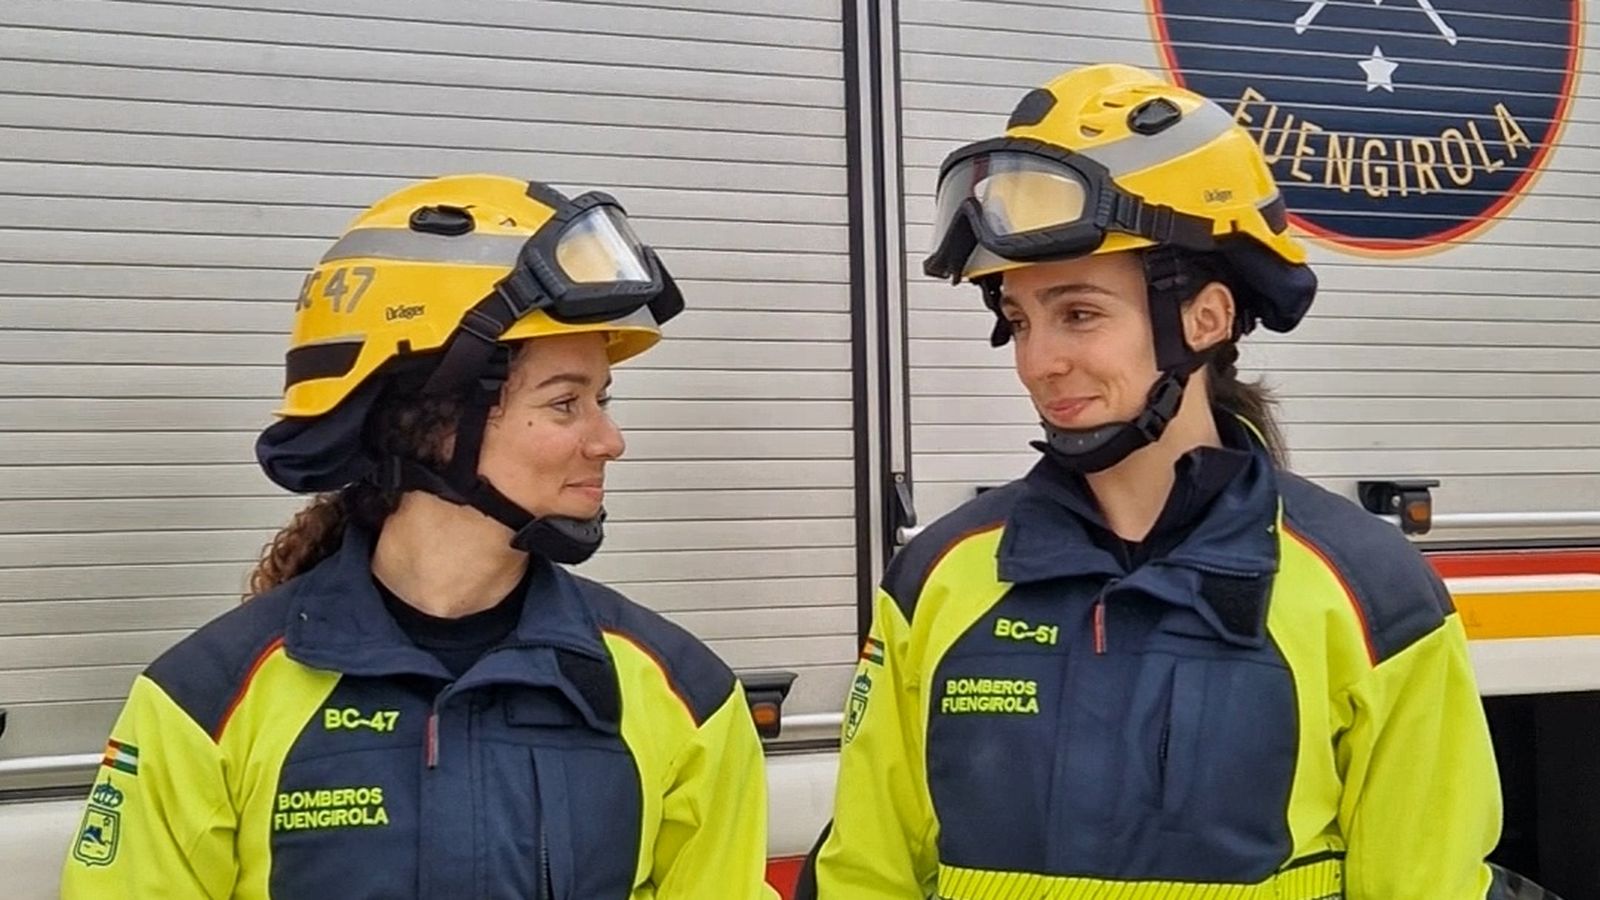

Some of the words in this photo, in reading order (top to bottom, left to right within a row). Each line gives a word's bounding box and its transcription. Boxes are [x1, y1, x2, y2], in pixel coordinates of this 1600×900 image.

[1233, 87, 1531, 197] FUENGIROLA
[323, 266, 376, 313] 47
[995, 618, 1058, 644] BC-51
[946, 679, 1037, 695] BOMBEROS
[942, 696, 1039, 713] FUENGIROLA
[325, 708, 399, 731] BC-47
[278, 787, 383, 810] BOMBEROS
[274, 807, 389, 830] FUENGIROLA
